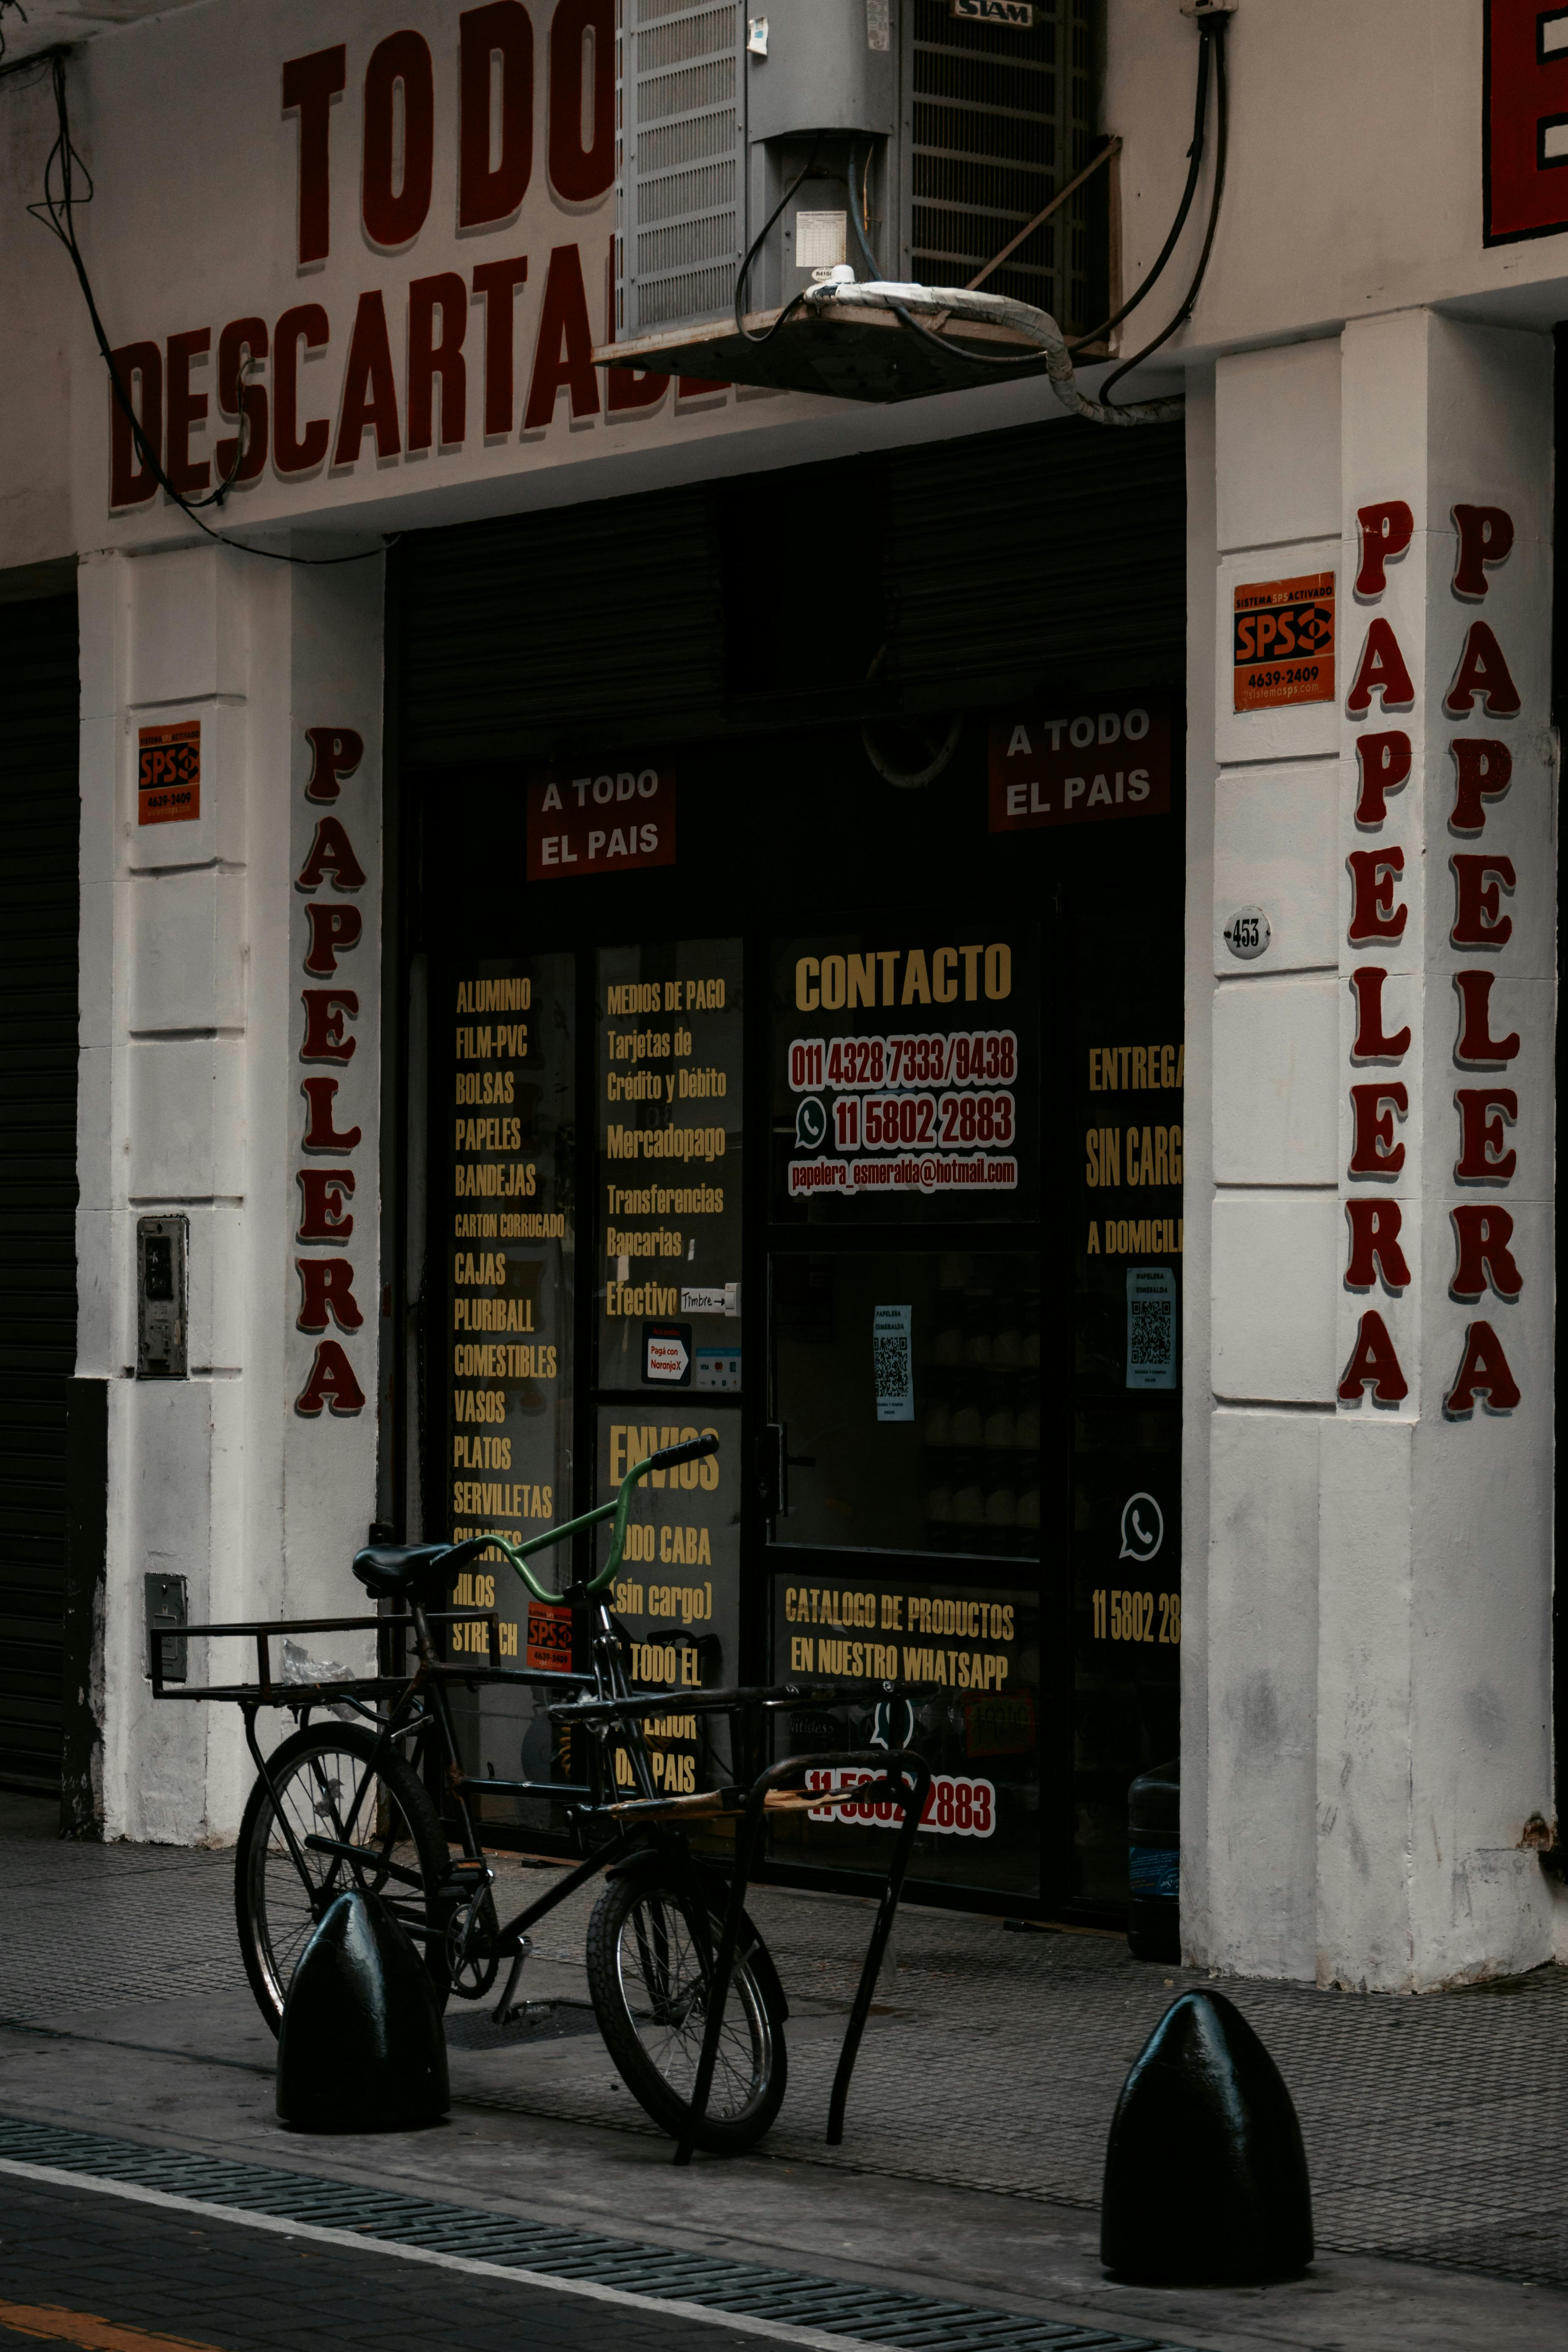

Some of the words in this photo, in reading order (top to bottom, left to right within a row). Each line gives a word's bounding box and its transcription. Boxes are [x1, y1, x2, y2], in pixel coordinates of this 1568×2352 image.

[959, 0, 1028, 23] SIAM
[282, 0, 615, 264] TODO
[111, 234, 794, 507] DESCARTA
[1236, 611, 1296, 660] SPS
[1249, 666, 1319, 688] 4639-2409
[1249, 683, 1319, 699] sistemasps.com
[1007, 724, 1032, 757] A
[1044, 708, 1149, 751] TODO
[140, 749, 177, 786] SPS
[148, 792, 191, 807] 4639-2409
[541, 783, 562, 812] A
[572, 769, 659, 807] TODO
[1007, 781, 1050, 816] EL
[1064, 768, 1150, 809] PAIS
[542, 836, 577, 865] EL
[588, 823, 659, 860] PAIS
[1233, 918, 1259, 948] 453
[1340, 501, 1415, 1400] PAPELERA
[1447, 504, 1523, 1411] PAPELERA
[796, 943, 1012, 1012] CONTACTO
[456, 978, 531, 1013] ALUMINIO
[608, 983, 661, 1015] MEDIOS
[665, 981, 682, 1011] DE
[686, 978, 725, 1010] PAGO
[456, 1024, 528, 1059] FILM-PVC
[607, 1029, 670, 1063] Tarjetas
[674, 1026, 692, 1056] de
[299, 727, 366, 1411] PAPELERA
[792, 1045, 822, 1085] 011
[828, 1042, 883, 1084] 4328
[890, 1036, 1014, 1081] 7333/9438
[456, 1071, 514, 1105] BOLSAS
[607, 1071, 661, 1101] Crédito
[665, 1074, 675, 1103] y
[679, 1067, 727, 1098] Débito
[456, 1117, 521, 1150] PAPELES
[836, 1102, 858, 1144] 11
[865, 1099, 934, 1144] 5802
[942, 1096, 1012, 1142] 2883
[607, 1123, 726, 1163] Mercadopago
[1086, 1127, 1120, 1188] SIN
[1126, 1125, 1183, 1187] CARG
[455, 1163, 536, 1197] BANDEJAS
[793, 1159, 1015, 1190] papelera_esmeralda@hotmail.com
[607, 1183, 724, 1214] Transferencias
[455, 1213, 498, 1237] CARTON
[500, 1213, 564, 1237] CORRUGADO
[607, 1226, 682, 1256] Bancarias
[1087, 1221, 1100, 1254] A
[454, 1252, 506, 1285] CAJAS
[454, 1298, 534, 1332] PLURIBALL
[606, 1281, 678, 1316] Efectivo
[682, 1292, 712, 1309] Timbre
[454, 1344, 557, 1379] COMESTIBLES
[651, 1346, 666, 1357] Pagá
[454, 1390, 506, 1423] VASOS
[454, 1436, 511, 1470] PLATOS
[454, 1481, 552, 1519] SERVILLETAS
[660, 1526, 712, 1565] CABA
[785, 1587, 875, 1628] CATALOGO
[881, 1595, 903, 1631] DE
[908, 1597, 1015, 1641] PRODUCTOS
[1092, 1588, 1107, 1639] 11
[1111, 1590, 1154, 1642] 5802
[1159, 1593, 1181, 1644] 28
[452, 1621, 518, 1656] STRECH
[528, 1619, 558, 1647] SPS
[534, 1651, 568, 1664] 4639-2409
[630, 1643, 676, 1683] TODO
[681, 1647, 702, 1686] EL
[791, 1637, 813, 1672] EN
[818, 1639, 898, 1680] NUESTRO
[903, 1646, 1008, 1691] WHATSAPP
[652, 1752, 696, 1793] PAIS
